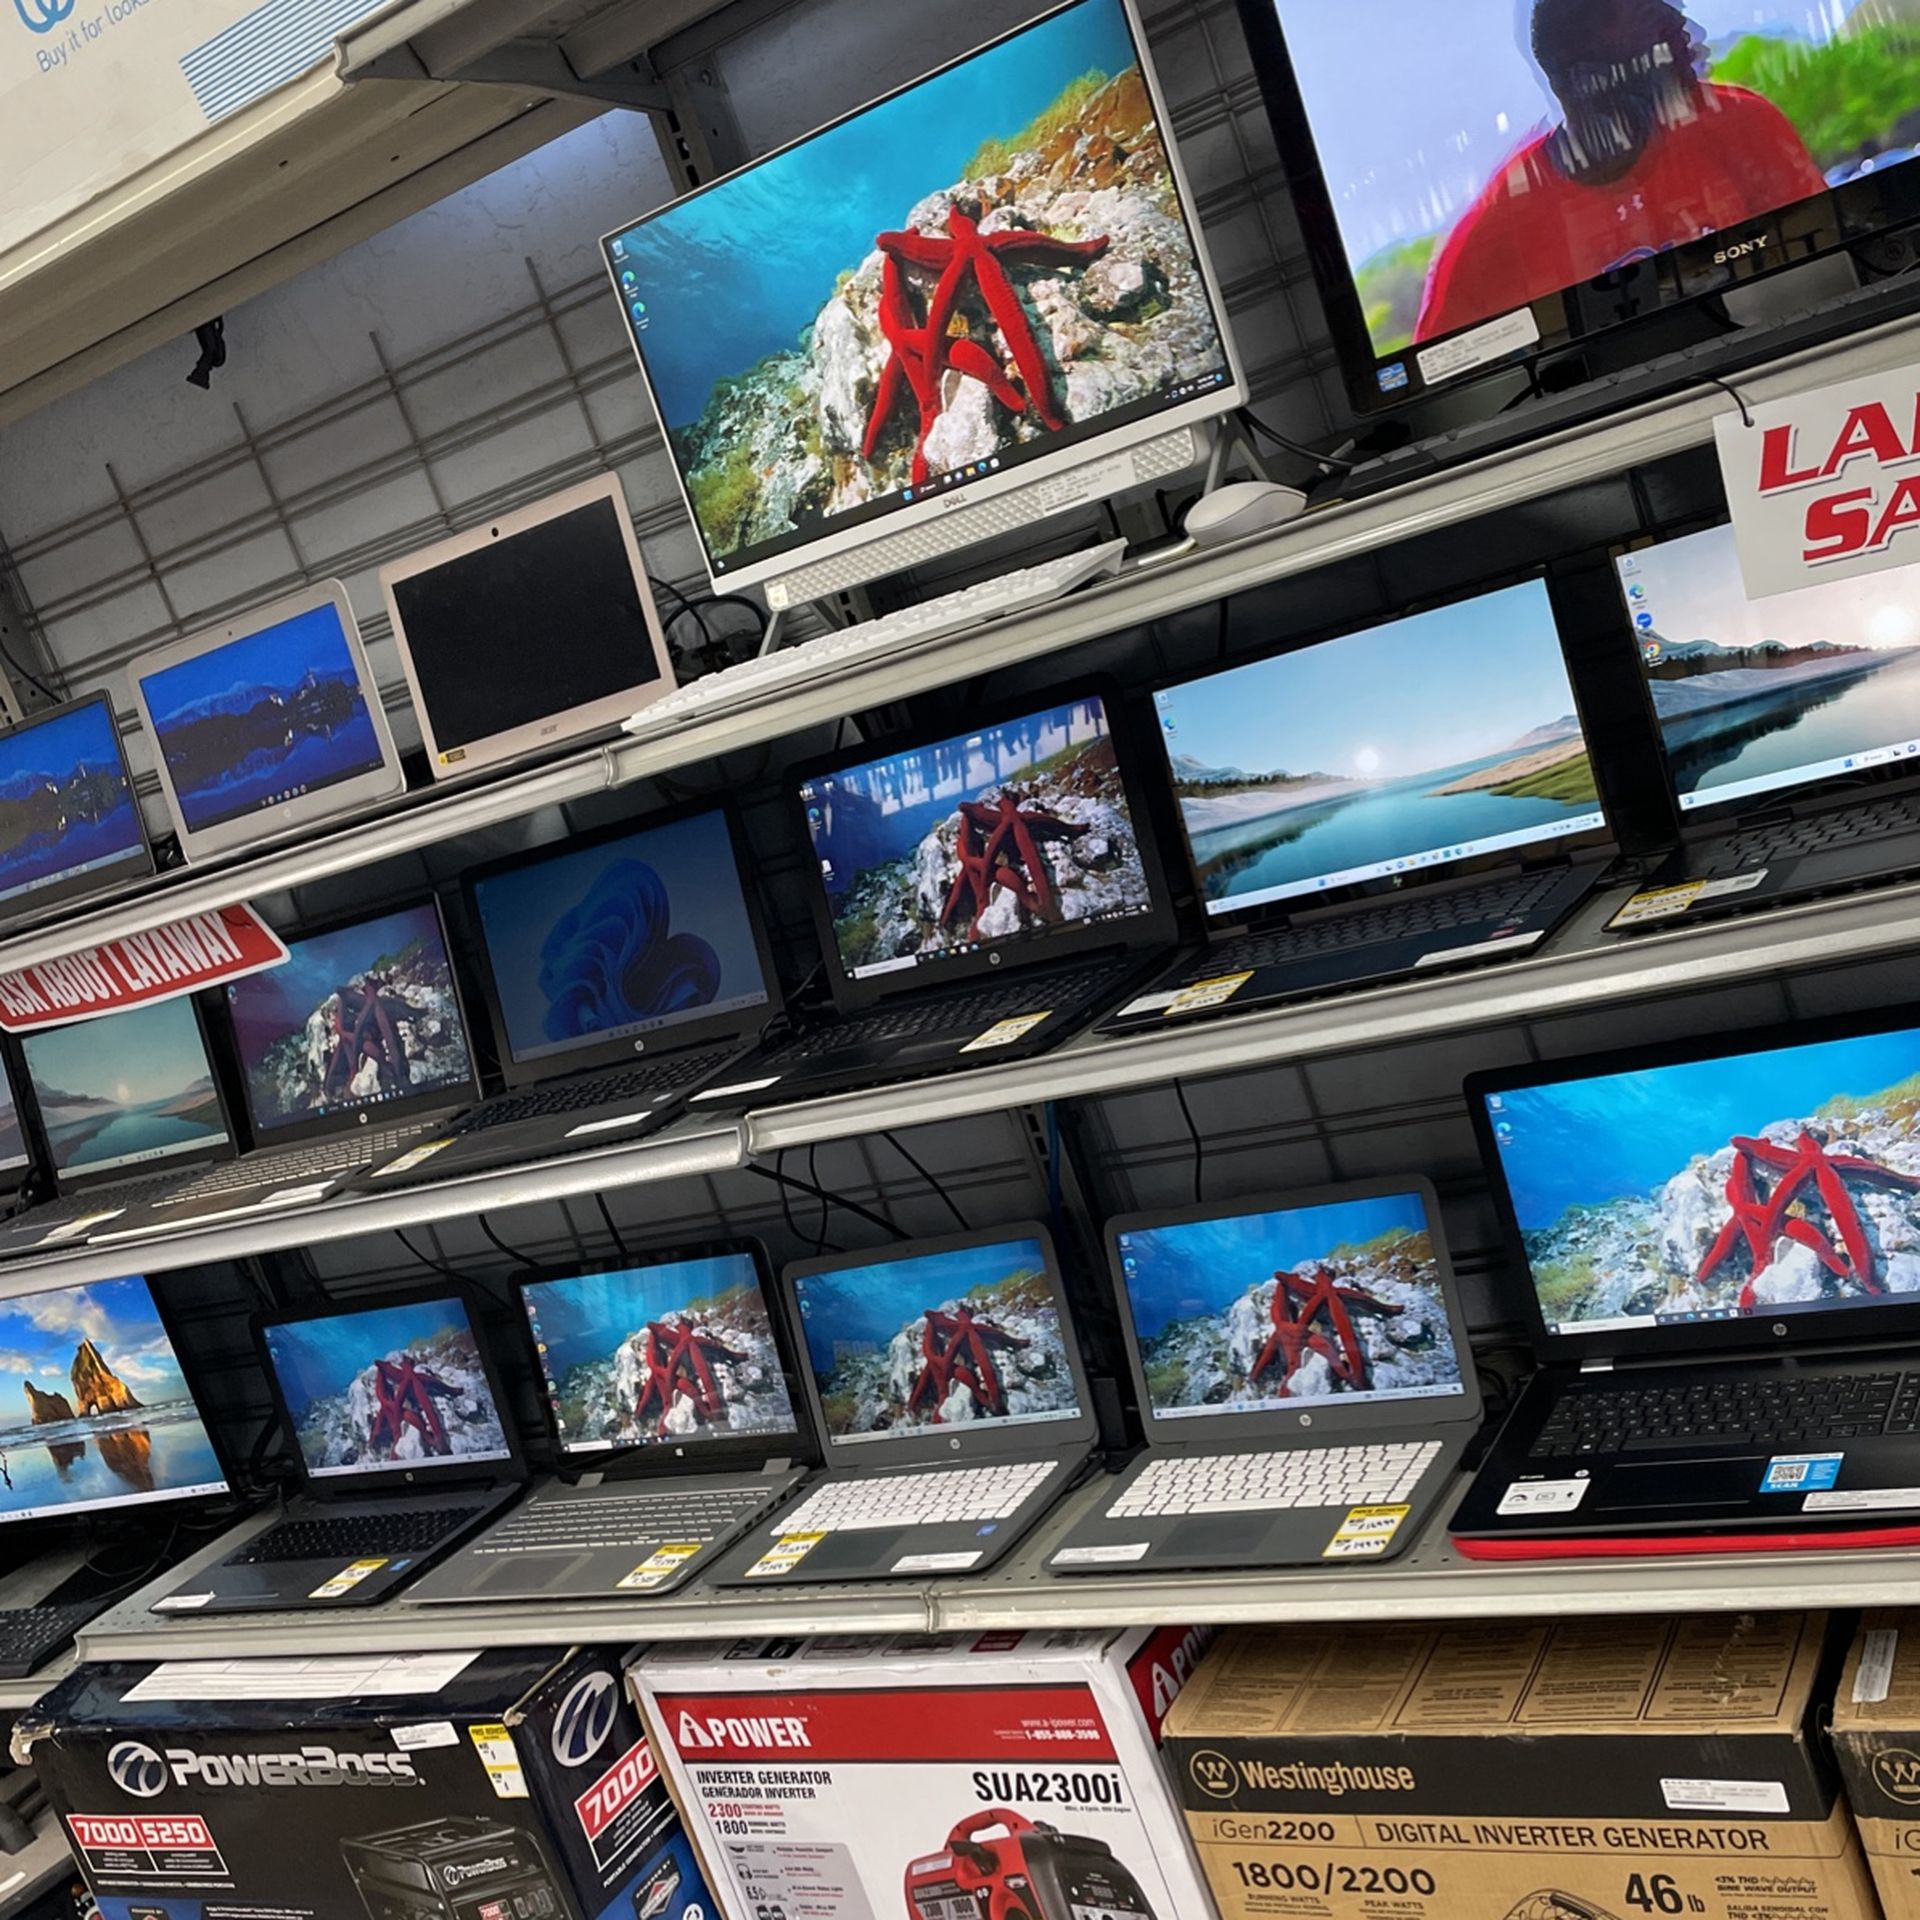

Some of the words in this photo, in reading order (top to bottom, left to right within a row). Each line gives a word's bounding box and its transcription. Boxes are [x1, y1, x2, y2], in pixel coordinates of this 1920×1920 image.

[36, 48, 68, 73] Buy
[66, 29, 83, 52] it
[80, 15, 104, 42] for
[103, 0, 151, 26] loo
[1713, 234, 1768, 264] SONY
[1758, 391, 1920, 492] LA
[943, 493, 968, 509] DELL
[0, 971, 51, 1017] ASK
[31, 948, 122, 1009] ABOUT
[104, 910, 243, 993] LAYAWAY
[1769, 1482, 1799, 1490] SCAN
[584, 1744, 655, 1829] 7000
[696, 1771, 755, 1785] INVERTER
[758, 1771, 832, 1786] GENERATOR
[972, 1771, 1123, 1803] SUA2300i
[1238, 1761, 1416, 1796] Westinghouse
[702, 1787, 763, 1799] GENERADOR
[765, 1788, 816, 1800] INVERTER
[708, 1803, 742, 1818] 2300
[75, 1822, 138, 1844] 7000
[141, 1822, 206, 1844] 5250
[715, 1820, 749, 1835] 1800
[1213, 1819, 1335, 1841] iGen2200
[1375, 1823, 1470, 1844] DIGITAL
[1473, 1824, 1597, 1847] INVERTER
[1602, 1826, 1770, 1850] GENERATOR
[1232, 1862, 1436, 1895] 1800/2200
[1717, 1884, 1741, 1892] SINE
[1744, 1885, 1773, 1893] WAVE
[1776, 1886, 1818, 1894] OUTPUT
[1738, 1875, 1760, 1884] THD
[1247, 1892, 1289, 1903] RUNNING
[1290, 1895, 1321, 1904] WATTS
[1364, 1899, 1389, 1909] PEAK
[1391, 1901, 1424, 1910] WATTS
[1625, 1873, 1683, 1915] 46
[1687, 1894, 1706, 1914] lb
